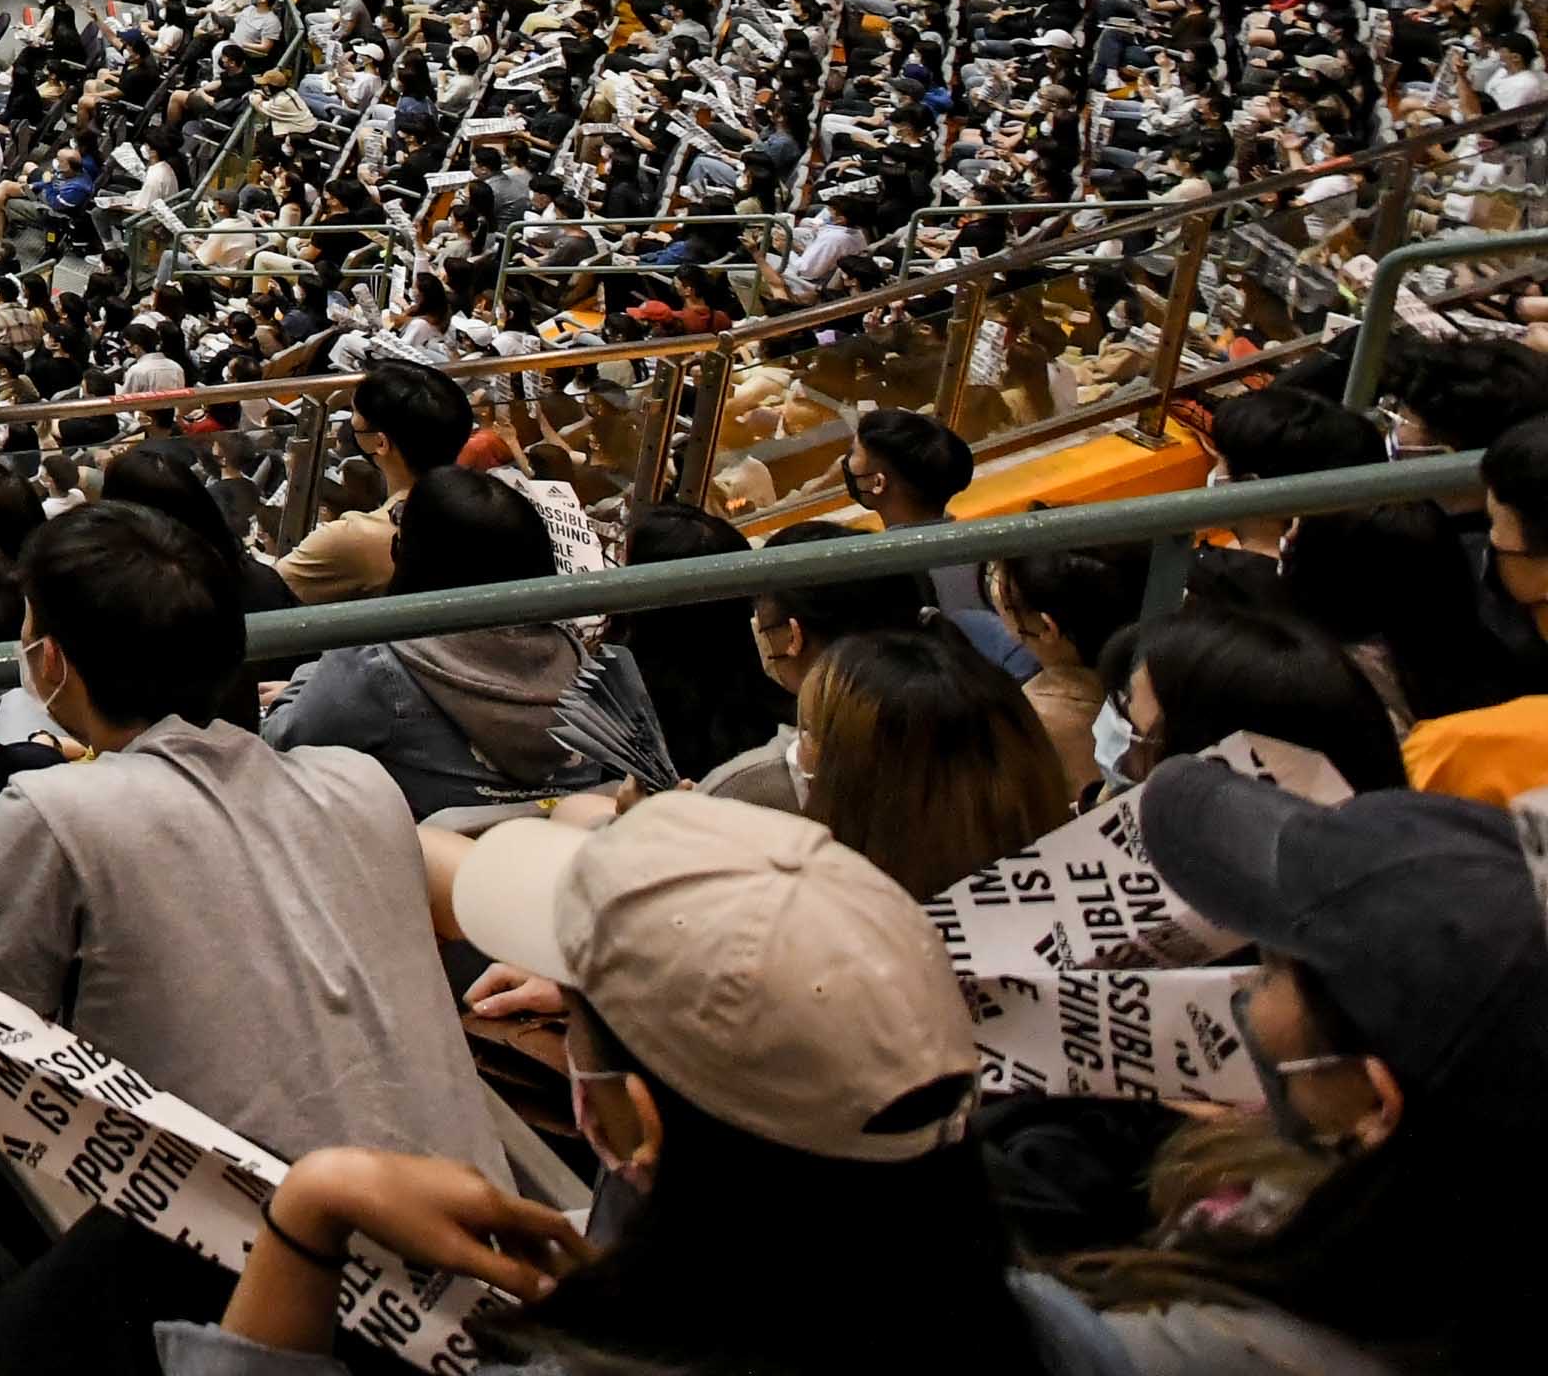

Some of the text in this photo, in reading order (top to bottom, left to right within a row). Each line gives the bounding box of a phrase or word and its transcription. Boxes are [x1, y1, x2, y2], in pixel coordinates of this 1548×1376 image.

[549, 521, 591, 544] THING
[1118, 801, 1149, 864] adidas
[1011, 868, 1056, 902] IS
